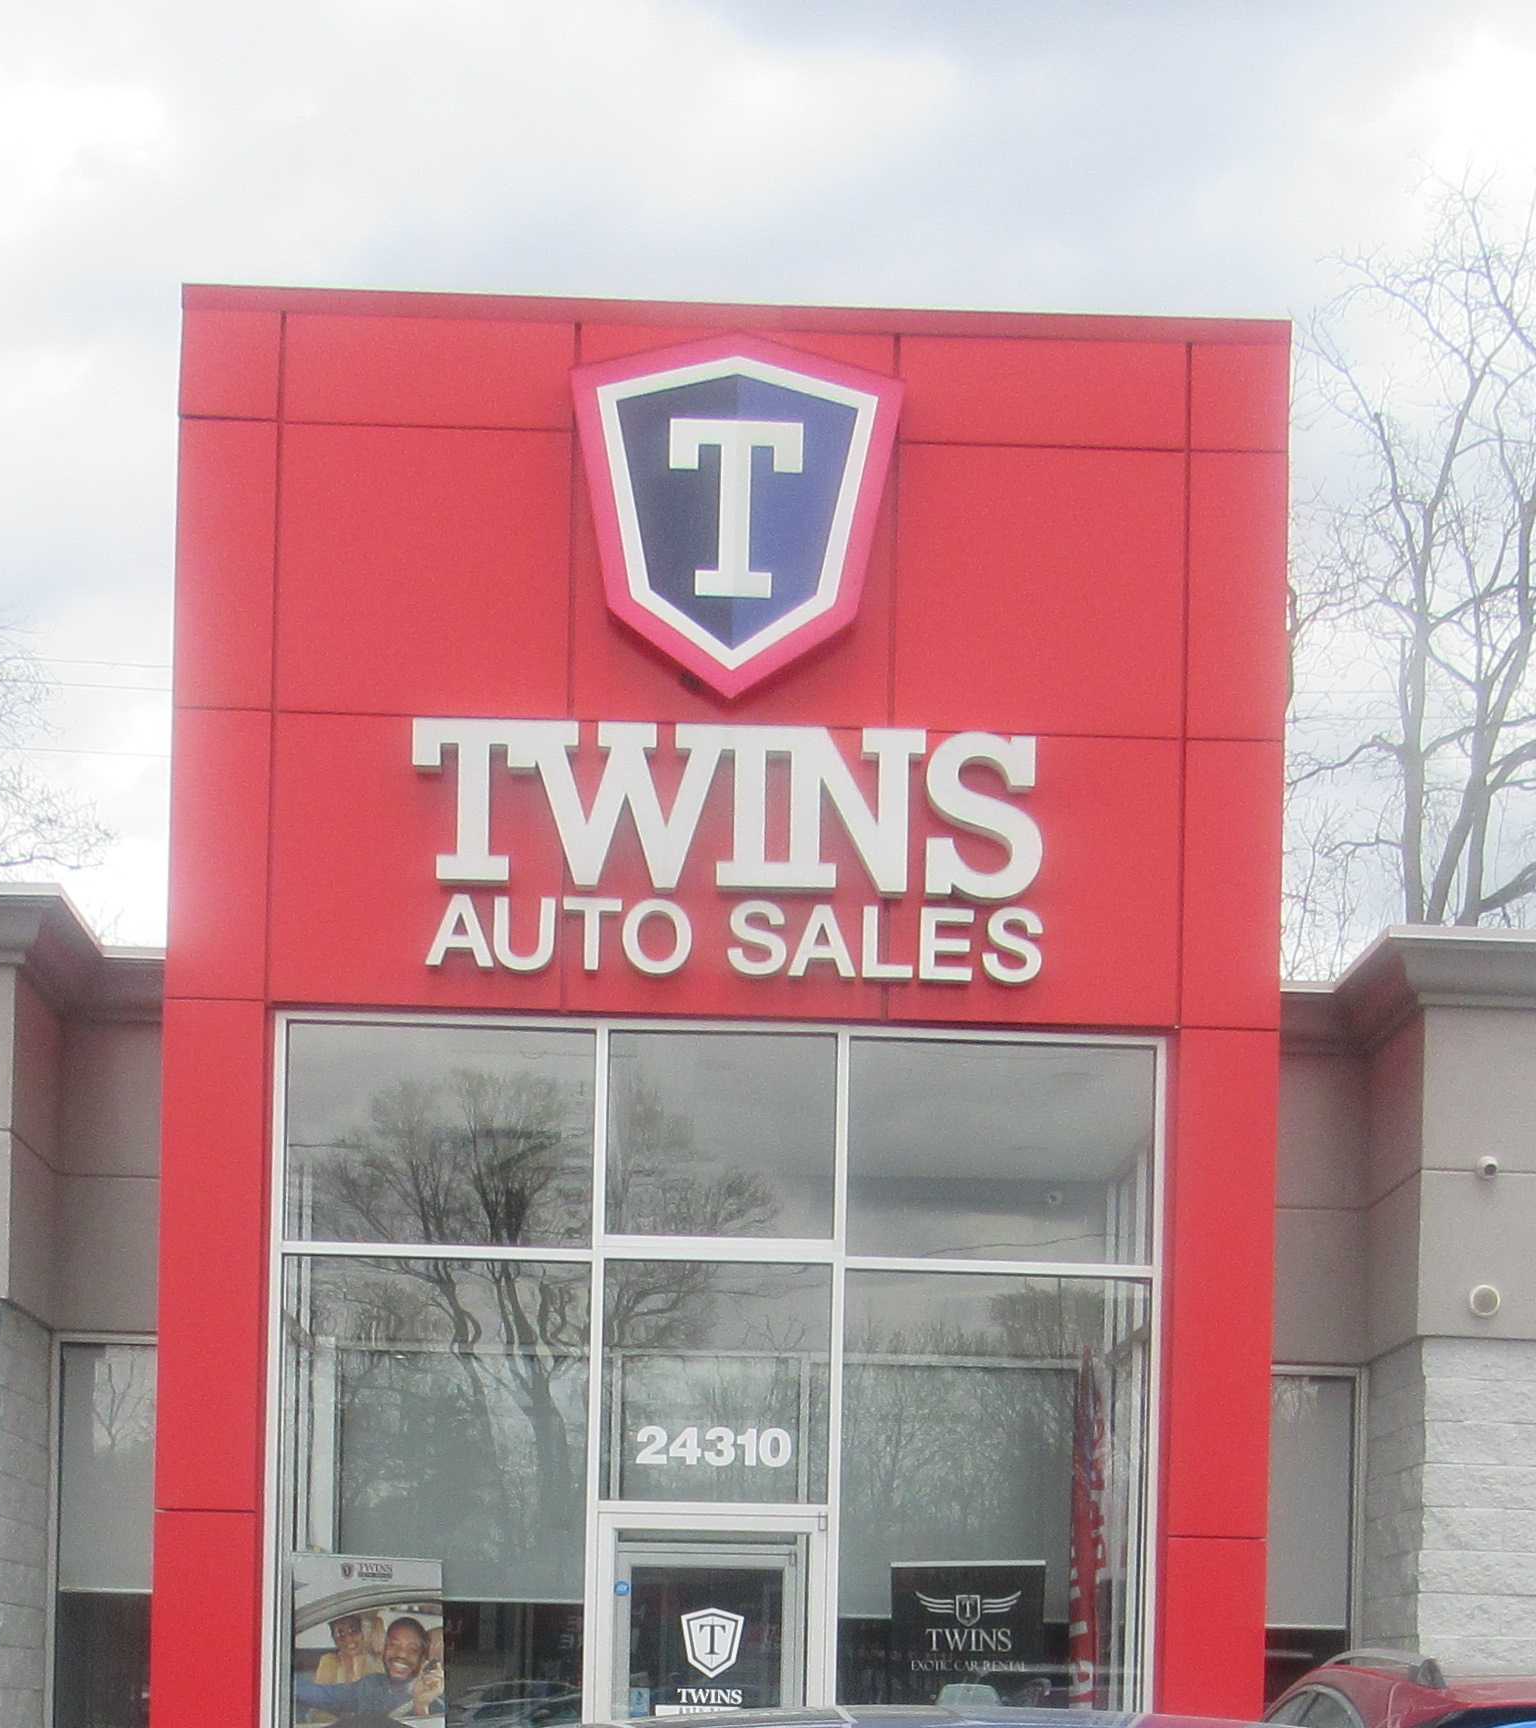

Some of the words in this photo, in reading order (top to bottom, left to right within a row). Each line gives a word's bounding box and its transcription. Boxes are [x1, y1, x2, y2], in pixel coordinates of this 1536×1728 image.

[669, 417, 804, 599] T
[412, 717, 1044, 903] TWINS
[424, 892, 694, 976] AUTO
[726, 900, 1044, 986] SALES
[635, 1425, 792, 1468] 24310
[699, 1624, 726, 1655] T
[925, 1628, 1013, 1652] TWINS
[911, 1660, 952, 1672] EXOTIC
[954, 1660, 978, 1672] CAR
[677, 1688, 743, 1705] TWINS
